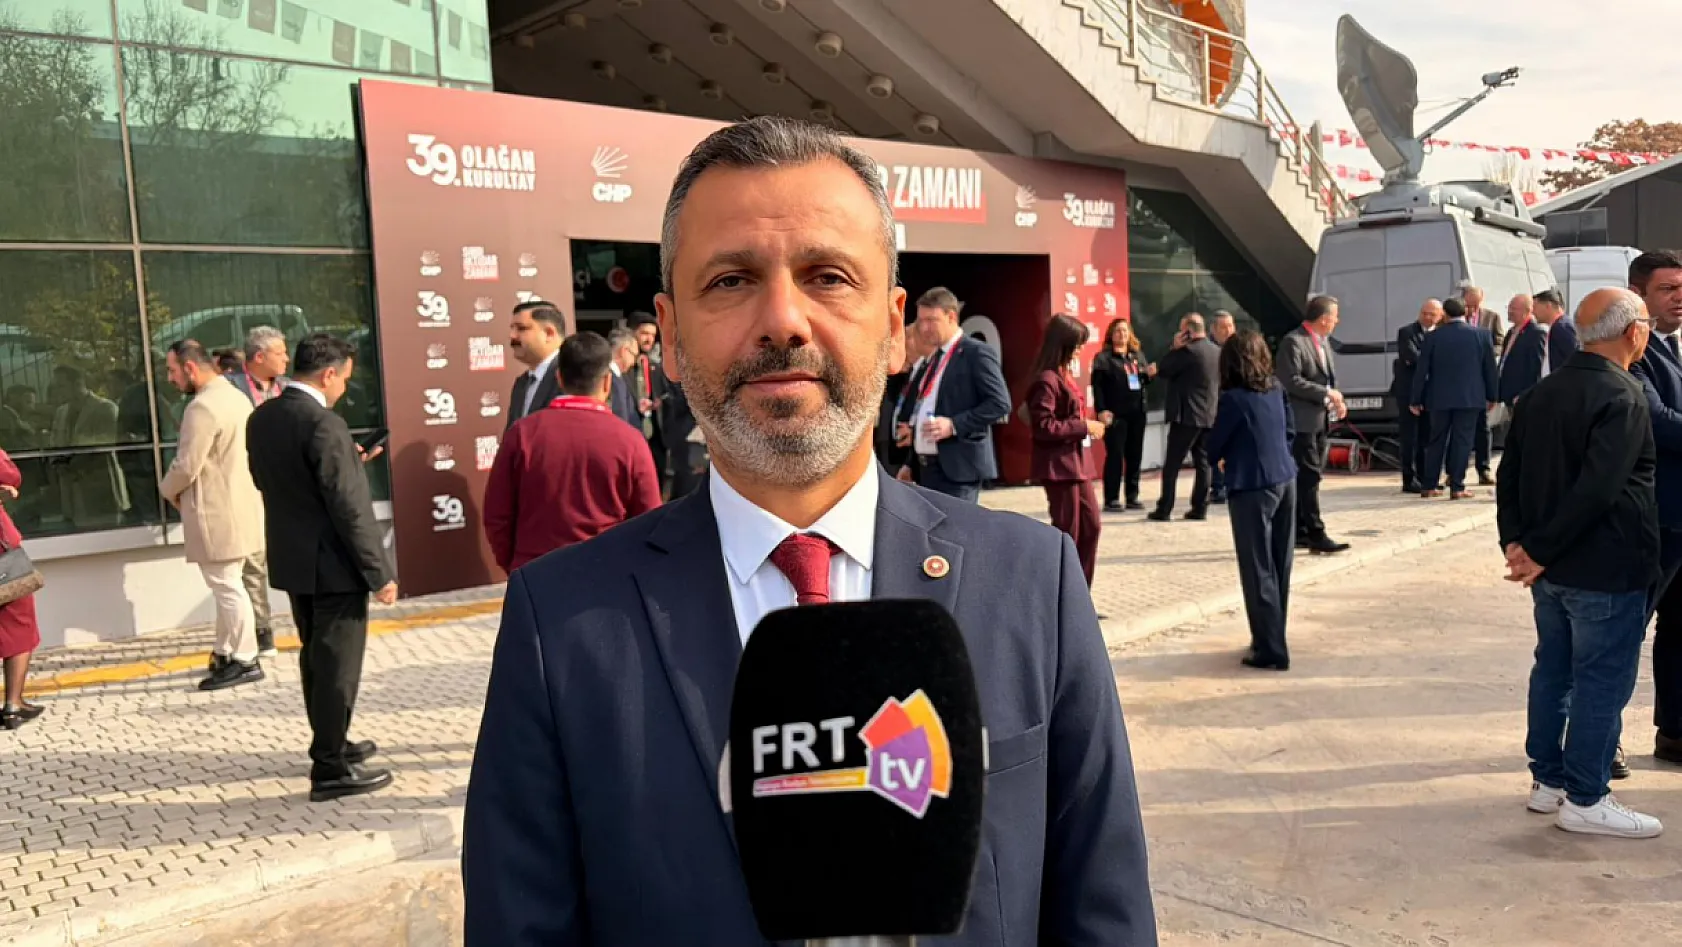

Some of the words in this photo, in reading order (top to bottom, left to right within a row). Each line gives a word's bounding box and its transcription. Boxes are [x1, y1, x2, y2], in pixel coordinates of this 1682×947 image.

[406, 133, 461, 187] 39.
[461, 144, 535, 172] OLAĞAN
[462, 168, 536, 191] KURULTAY
[592, 182, 632, 203] CHP
[893, 166, 982, 209] ZAMANI
[752, 715, 856, 774] FRT
[880, 751, 926, 791] tv
